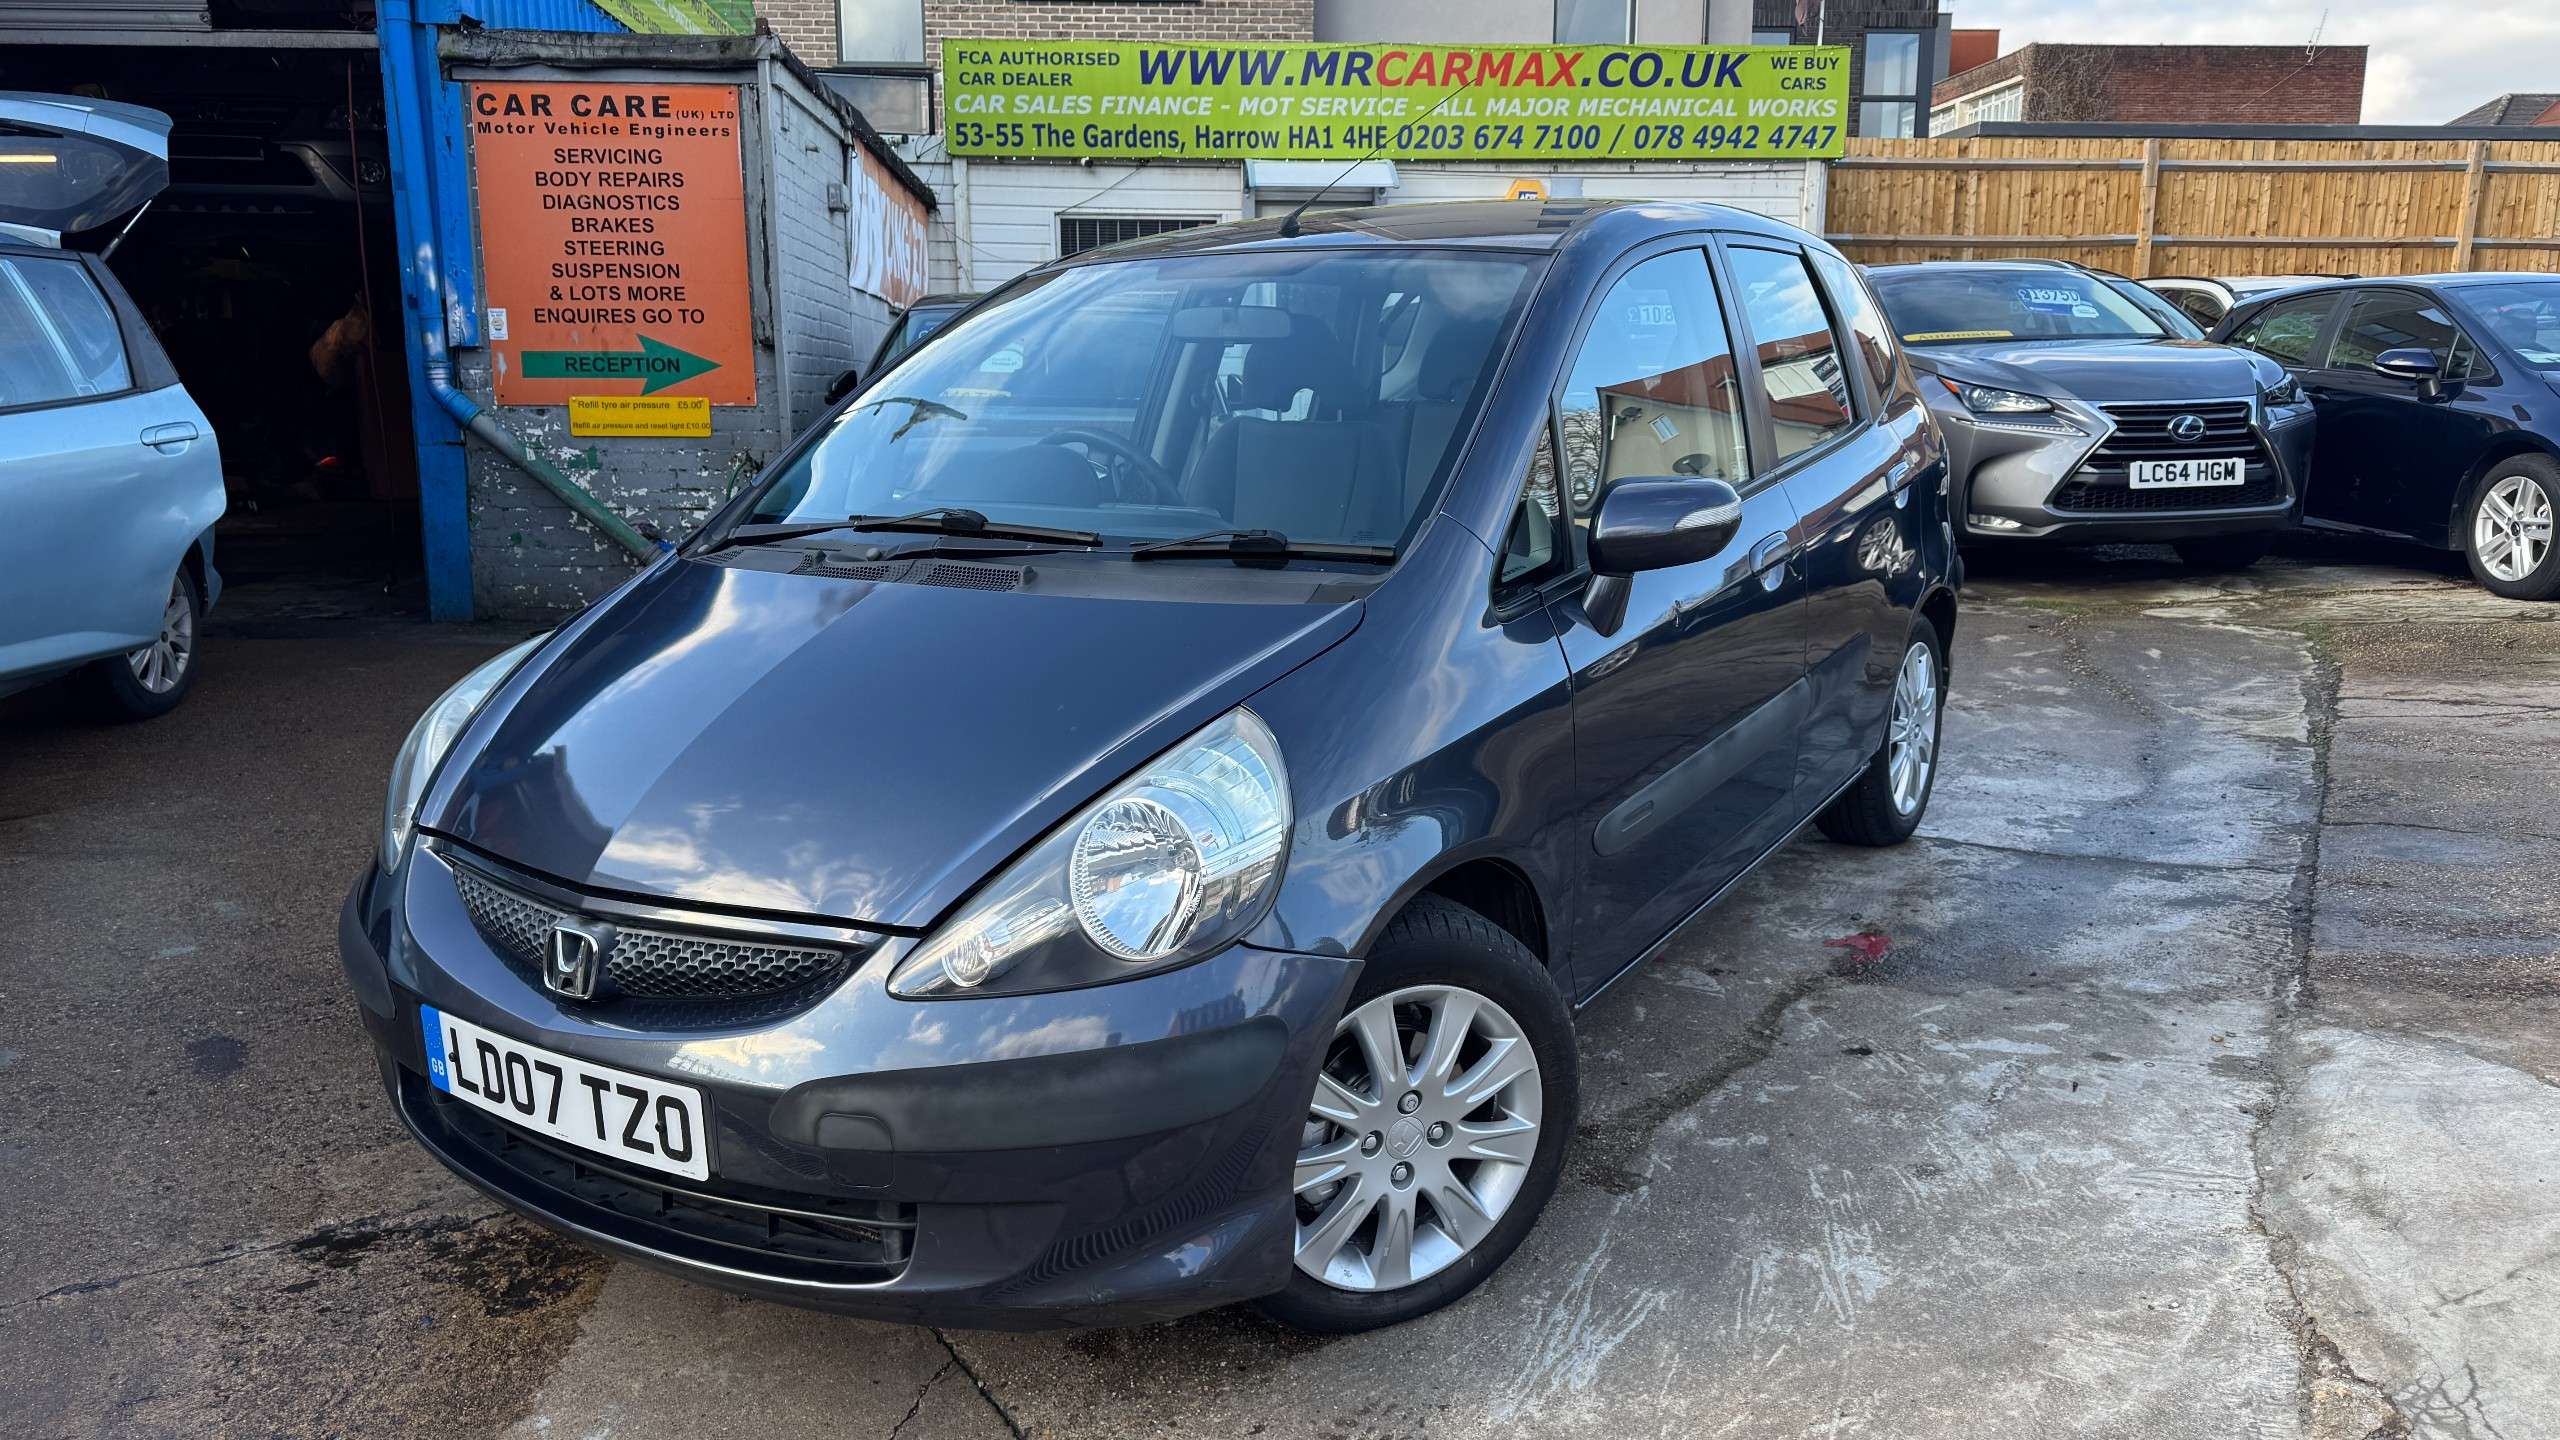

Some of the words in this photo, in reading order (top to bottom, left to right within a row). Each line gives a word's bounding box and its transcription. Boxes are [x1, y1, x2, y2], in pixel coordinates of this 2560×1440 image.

[958, 50, 996, 65] FCA
[1000, 50, 1120, 66] AUTHORISED
[1770, 57, 1798, 69] WE
[1804, 57, 1839, 70] BUY
[1139, 50, 1751, 87] WWW.MRCARMAX.CO.UK
[959, 72, 998, 86] CAR
[1002, 72, 1072, 87] DEALER
[1780, 77, 1827, 90] CARS
[476, 93, 553, 117] CAR
[571, 94, 672, 118] CARE
[676, 110, 704, 120] (UK)
[711, 110, 735, 119] LTD
[955, 94, 1007, 114] CAR
[1013, 95, 1092, 115] SALES
[1100, 96, 1212, 116] FINANCE
[1238, 97, 1295, 116] MOT
[1300, 97, 1408, 117] SERVICE
[1435, 97, 1477, 117] ALL
[1485, 97, 1569, 117] MAJOR
[1577, 97, 1737, 117] MECHANICAL
[1748, 97, 1837, 118] WORKS
[477, 122, 535, 135] Motor
[544, 122, 620, 136] Vehicle
[630, 123, 731, 139] Engineers
[955, 122, 1024, 148] 53-55
[1031, 122, 1075, 148] The
[1087, 123, 1185, 153] Gardens,
[1195, 124, 1279, 149] Harrow
[1289, 124, 1333, 149] HA1
[1343, 124, 1387, 149] 4HE
[1397, 125, 1463, 150] 0203
[1473, 125, 1523, 150] 674
[1535, 125, 1600, 150] 7100
[1608, 124, 1625, 153] /
[1633, 125, 1684, 150] 078
[1692, 125, 1758, 150] 4942
[1767, 125, 1837, 150] 4747
[554, 149, 662, 164] SERVICING
[535, 171, 591, 187] BODY
[598, 172, 684, 188] REPAIRS
[543, 194, 680, 210] DIAGNOSTICS
[572, 217, 654, 233] BRAKES
[564, 240, 665, 256] STEERING
[552, 263, 680, 279] SUSPENSION
[550, 286, 563, 301] &
[570, 286, 620, 301] LOTS
[628, 286, 686, 301] MORE
[534, 308, 636, 324] ENQUIRES
[643, 308, 672, 324] GO
[679, 308, 705, 324] TO
[565, 356, 680, 374] RECEPTION
[578, 400, 599, 409] Refill
[601, 400, 618, 411] tyre
[620, 400, 630, 409] air
[633, 401, 670, 411] pressure
[677, 400, 702, 409] £5.00
[2138, 462, 2191, 484] LC64
[2196, 460, 2237, 482] HGM
[431, 1056, 444, 1077] GB
[449, 1026, 563, 1126] LD07
